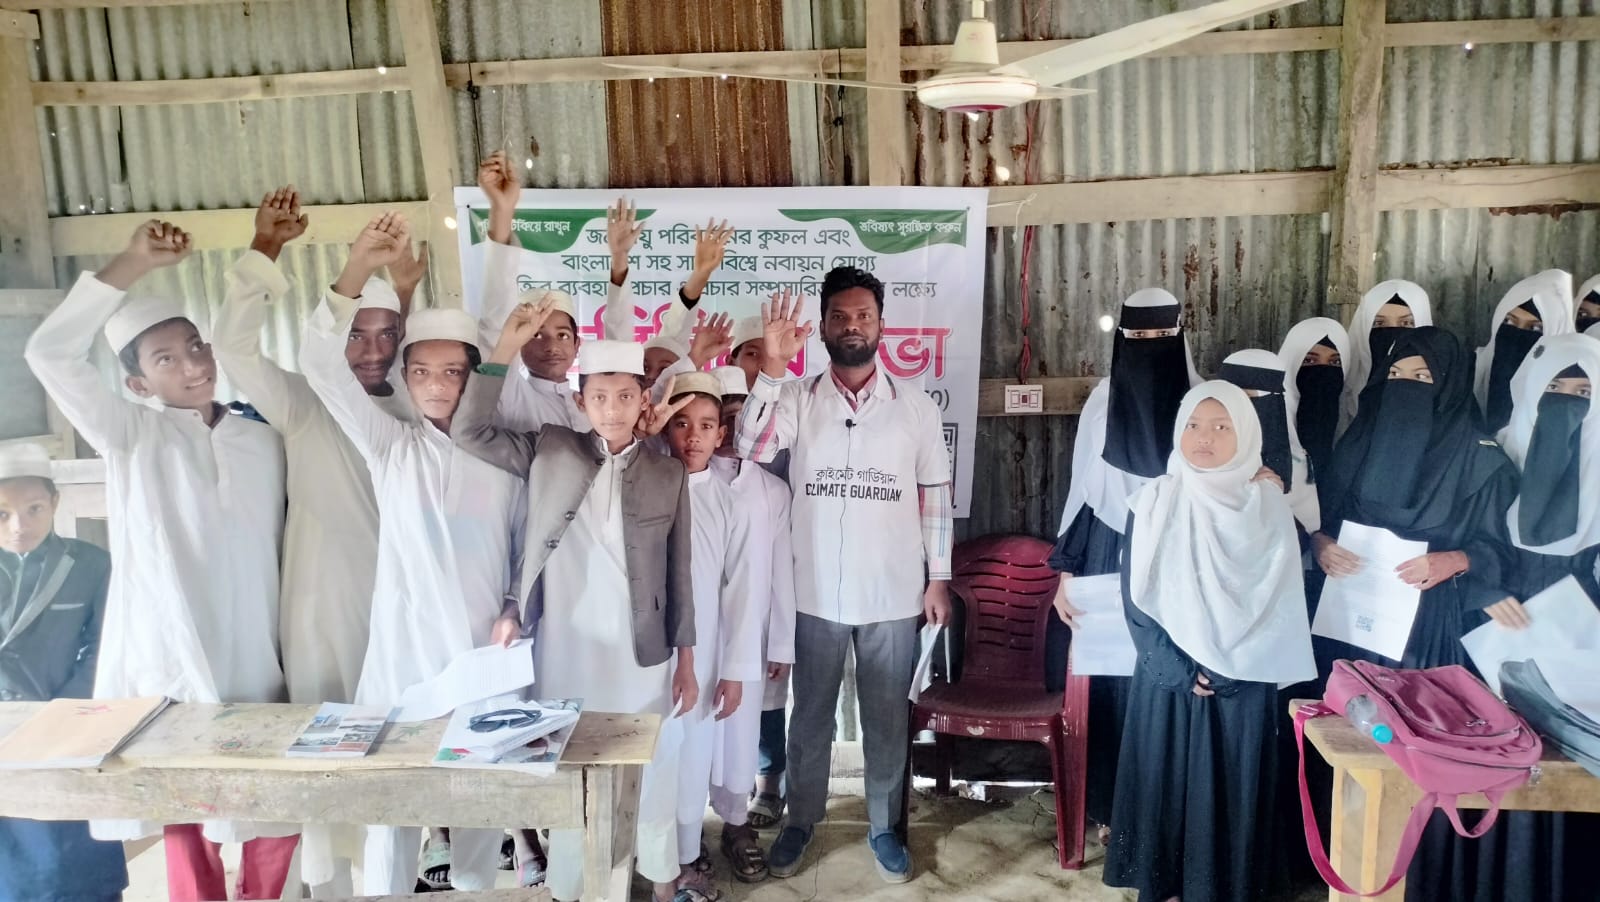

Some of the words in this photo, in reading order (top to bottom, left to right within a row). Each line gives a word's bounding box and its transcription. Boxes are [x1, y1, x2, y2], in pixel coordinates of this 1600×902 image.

[543, 221, 571, 236] রাখুন
[859, 219, 895, 233] ভবিষ্যৎ
[897, 219, 932, 237] সুরক্ষিত
[933, 222, 962, 233] করুন
[757, 229, 808, 250] কুফল
[814, 229, 851, 247] এবং
[646, 255, 672, 271] সহ
[763, 255, 825, 272] নবায়ন
[891, 282, 938, 298] লক্ষ্যে
[814, 466, 854, 481] ক্লাইমেট
[857, 467, 897, 485] গার্ডিয়ান
[805, 483, 847, 498] CLIMATE
[850, 484, 903, 502] GUARDIAN
